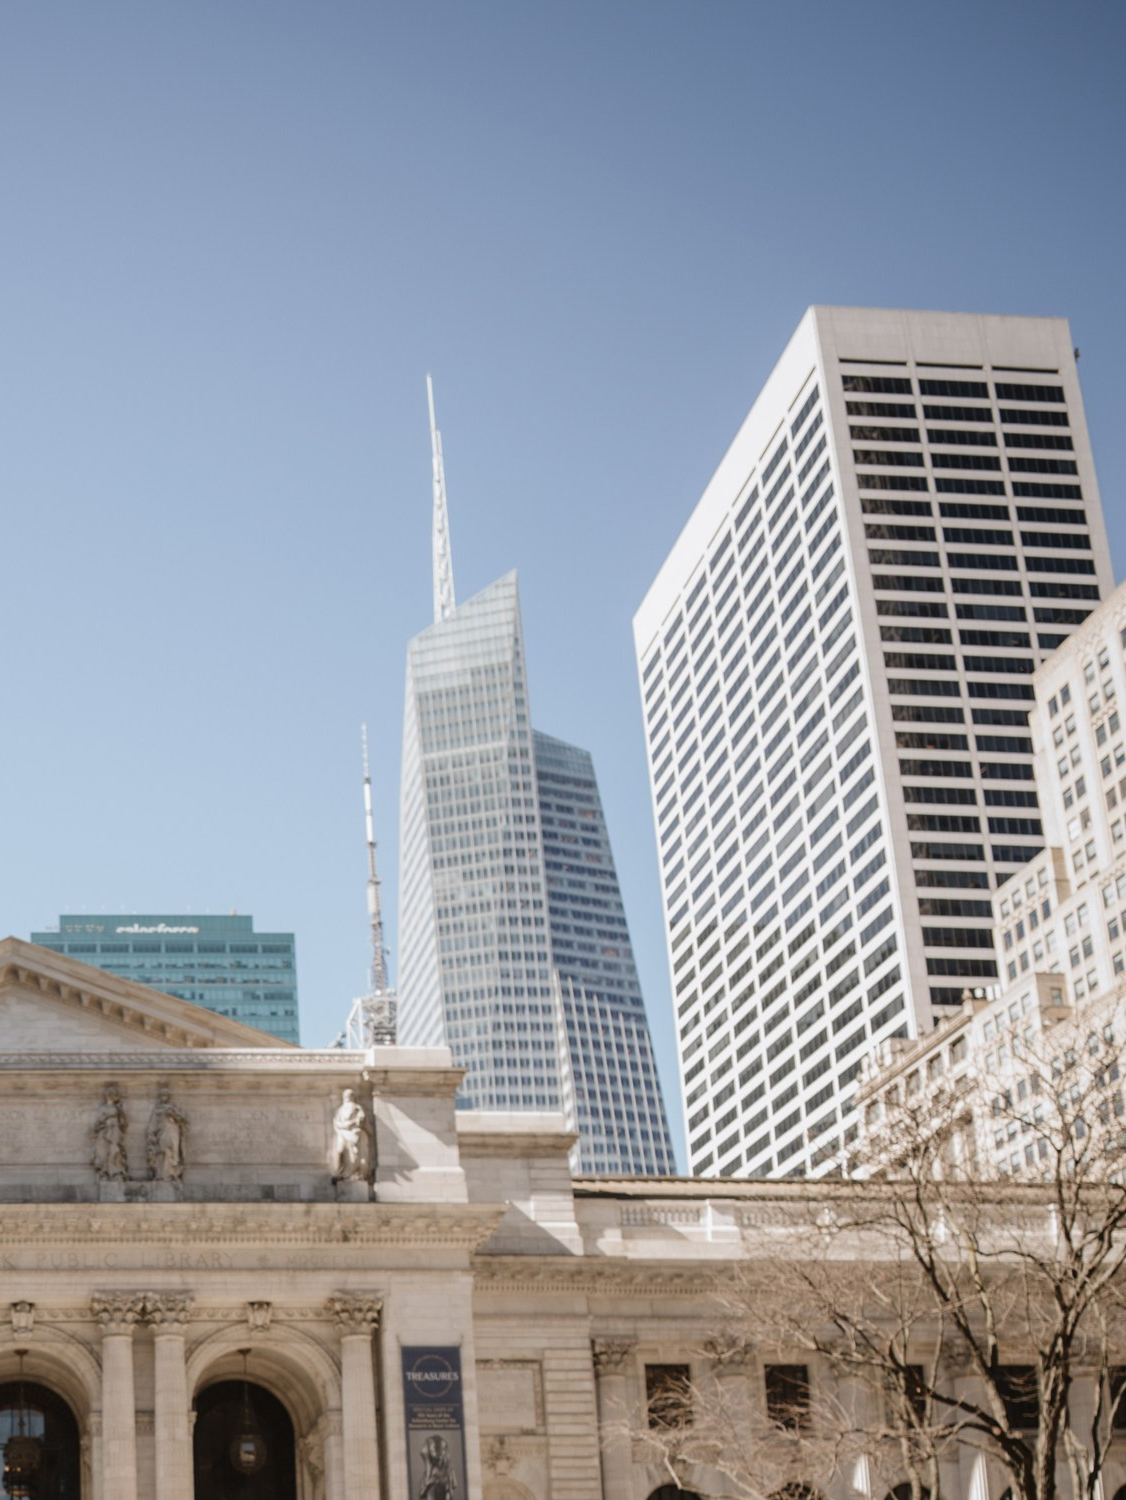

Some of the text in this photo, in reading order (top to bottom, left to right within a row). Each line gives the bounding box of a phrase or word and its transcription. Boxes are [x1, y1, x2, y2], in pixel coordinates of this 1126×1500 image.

[35, 1252, 120, 1269] PUBLIC
[141, 1252, 237, 1269] LIBRARY
[405, 1371, 459, 1381] TREASURES
